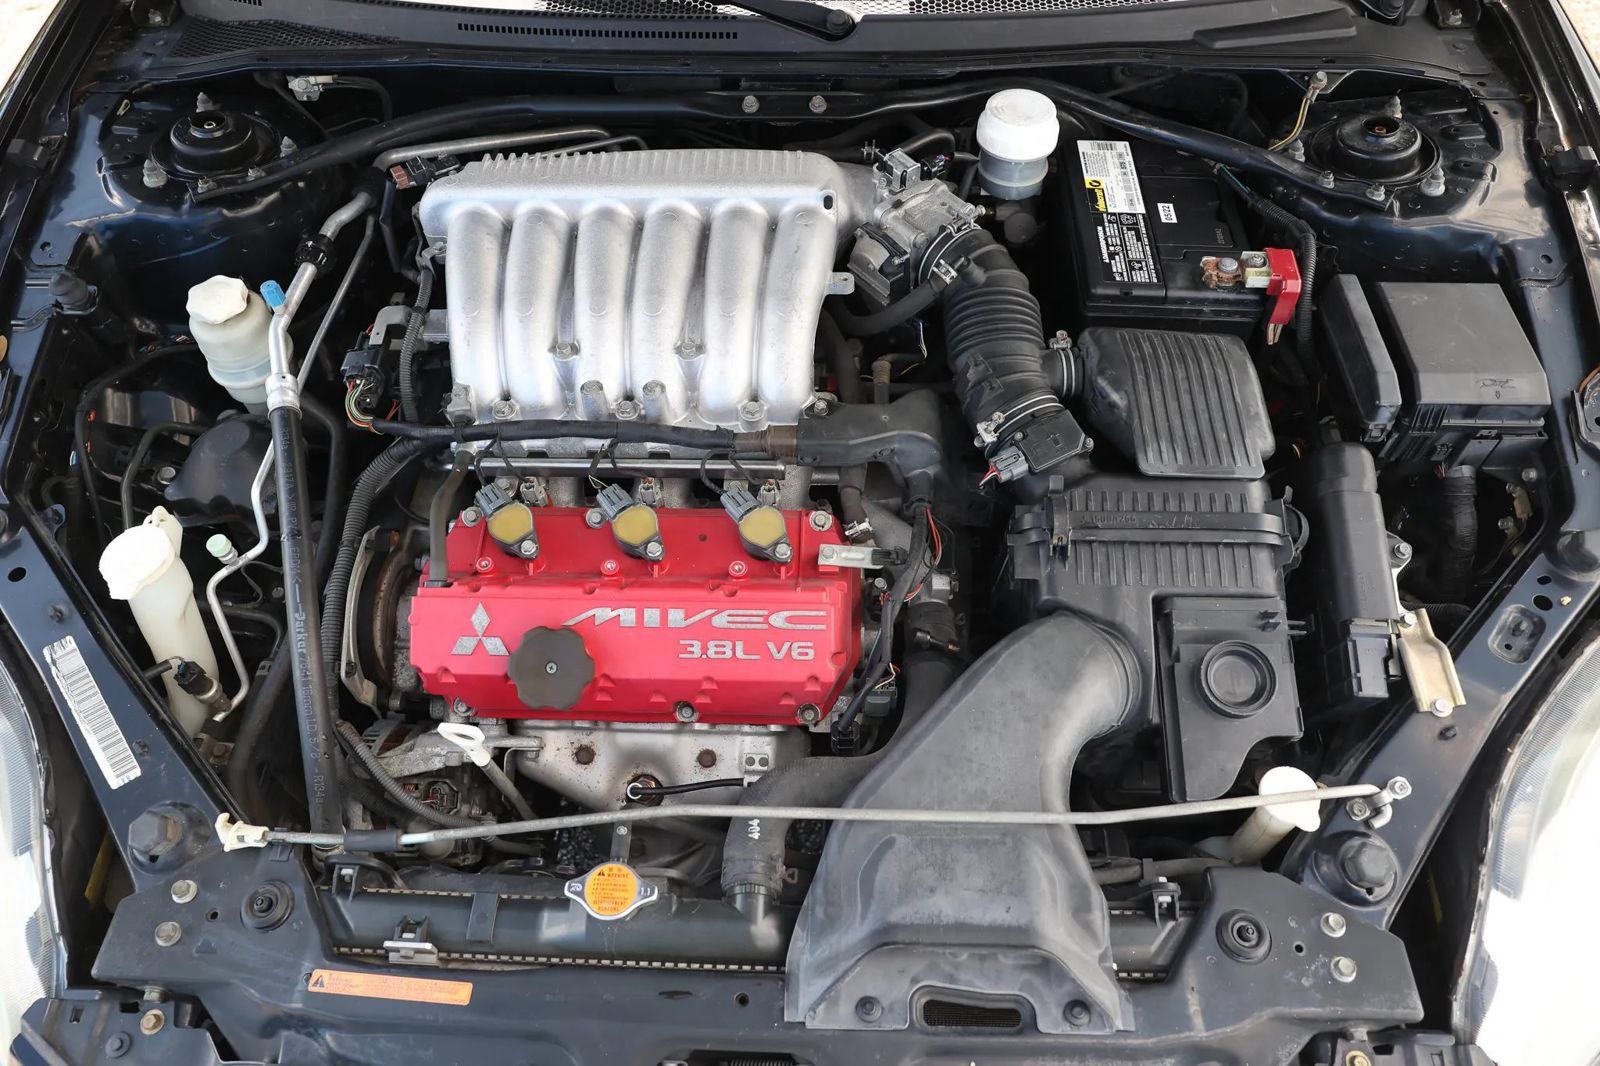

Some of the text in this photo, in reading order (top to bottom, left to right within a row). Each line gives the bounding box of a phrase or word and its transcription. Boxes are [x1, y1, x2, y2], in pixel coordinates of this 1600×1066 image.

[561, 607, 827, 631] MIVEC
[678, 640, 815, 660] 3.8L V6
[295, 611, 308, 653] Parker
[313, 775, 325, 803] R134a
[748, 818, 761, 840] 404
